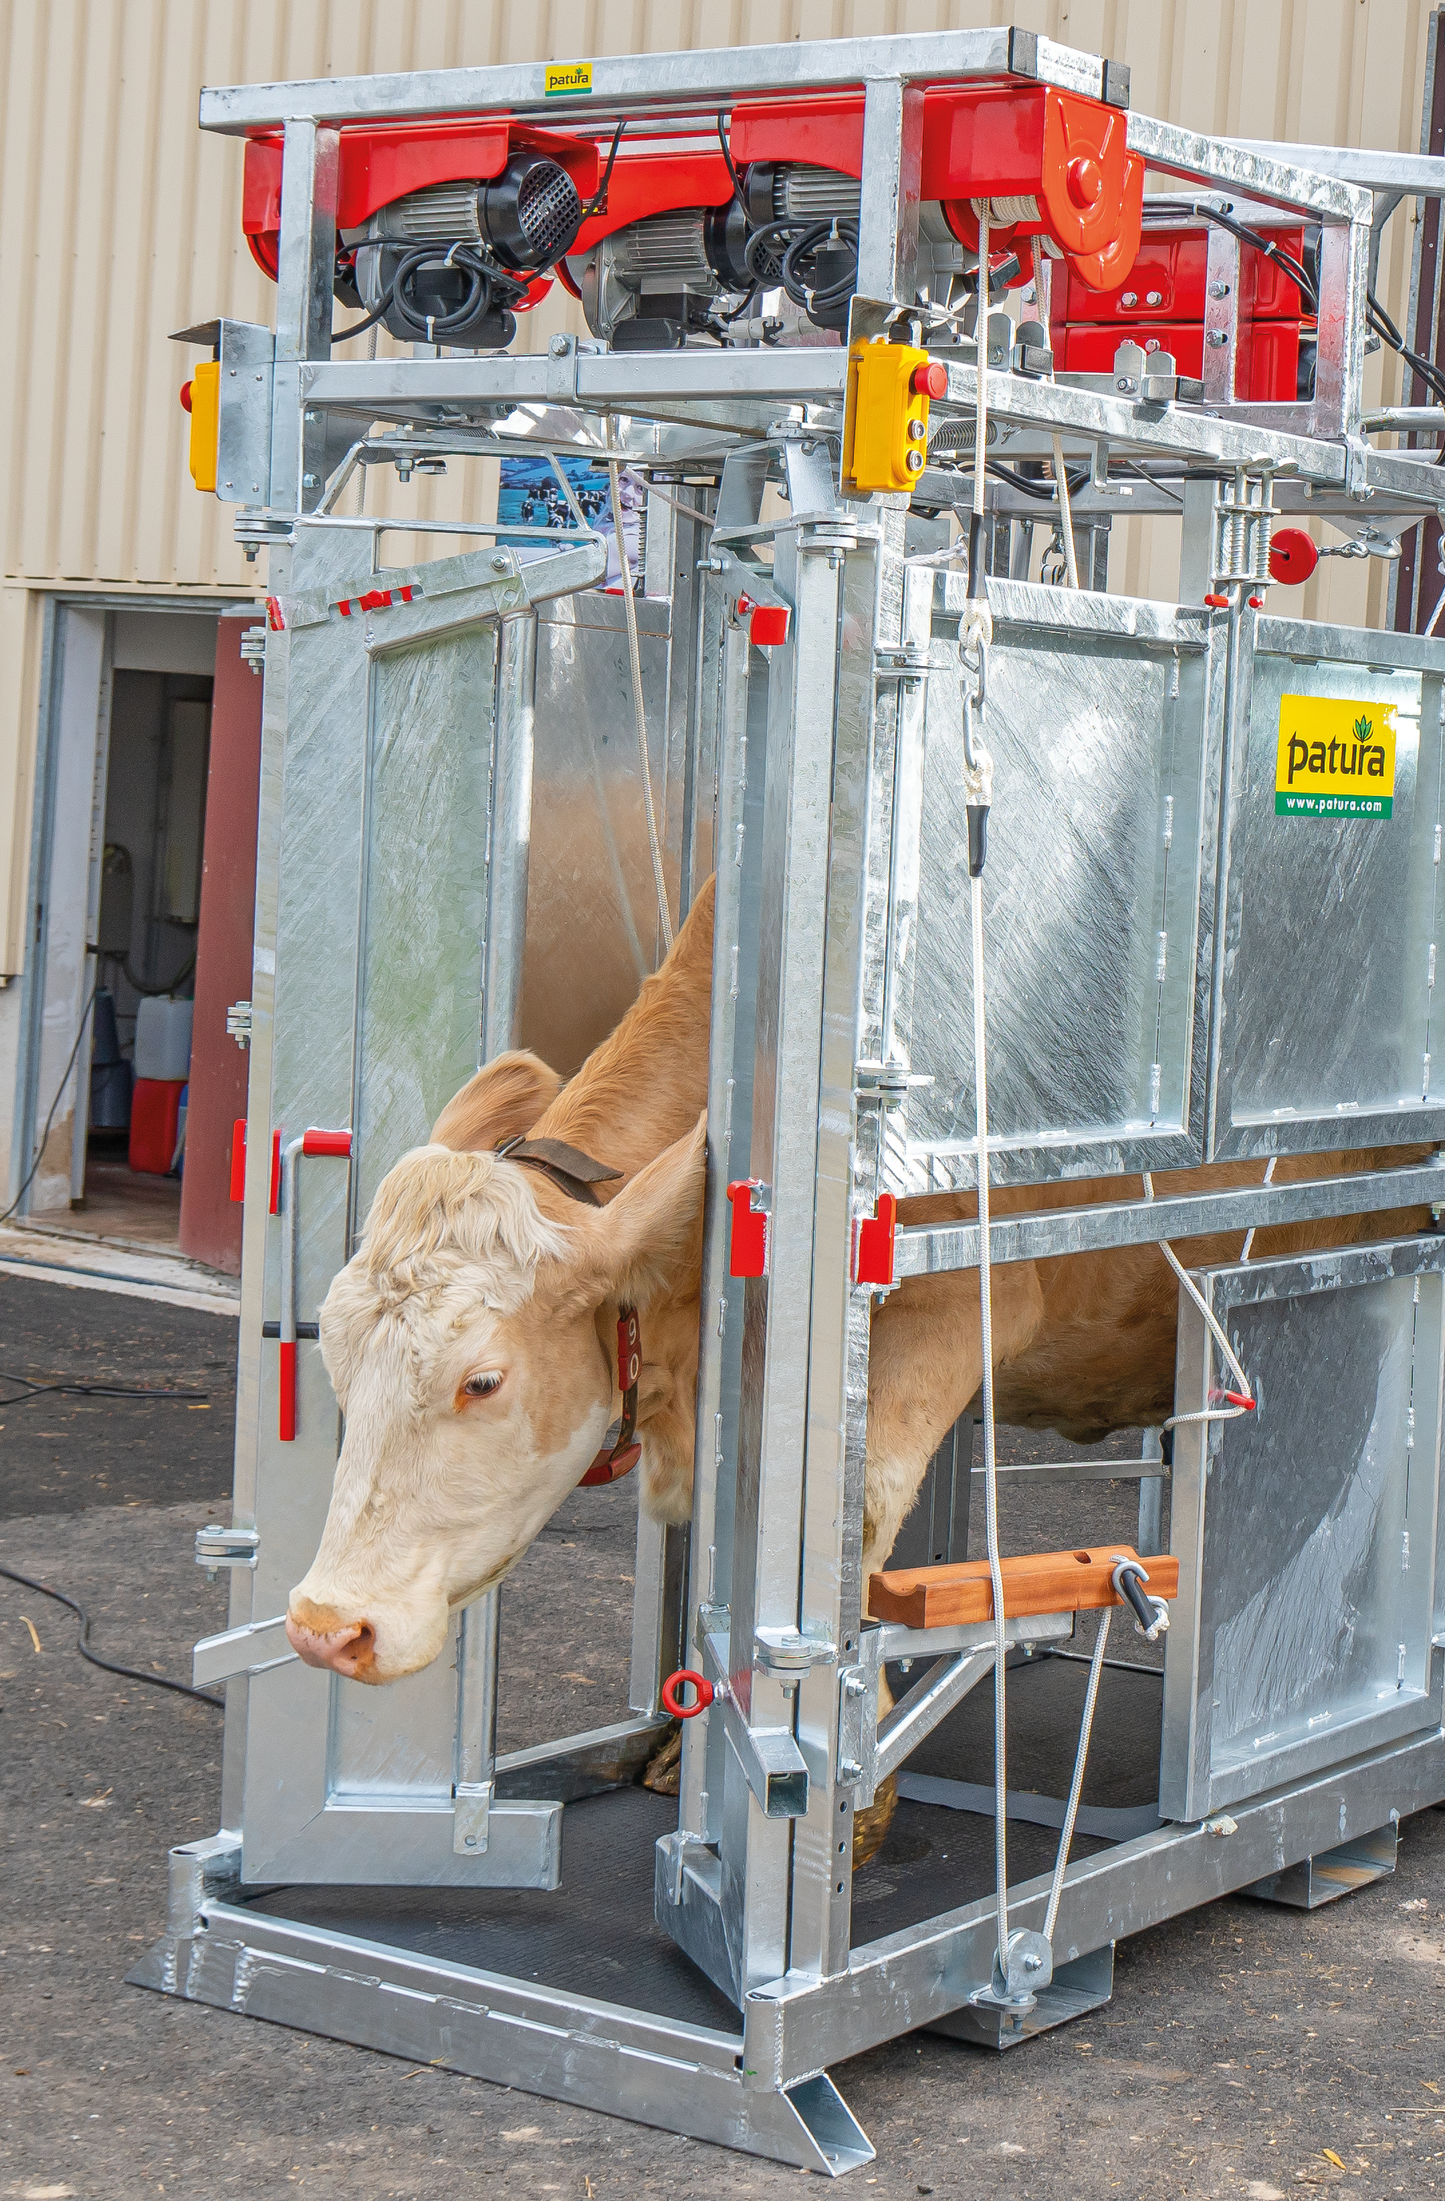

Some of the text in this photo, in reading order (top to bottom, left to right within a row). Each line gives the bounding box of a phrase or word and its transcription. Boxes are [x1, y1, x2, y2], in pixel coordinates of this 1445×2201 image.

[549, 74, 589, 89] patura
[1287, 730, 1386, 785] patura
[1286, 798, 1383, 814] www.patura.com
